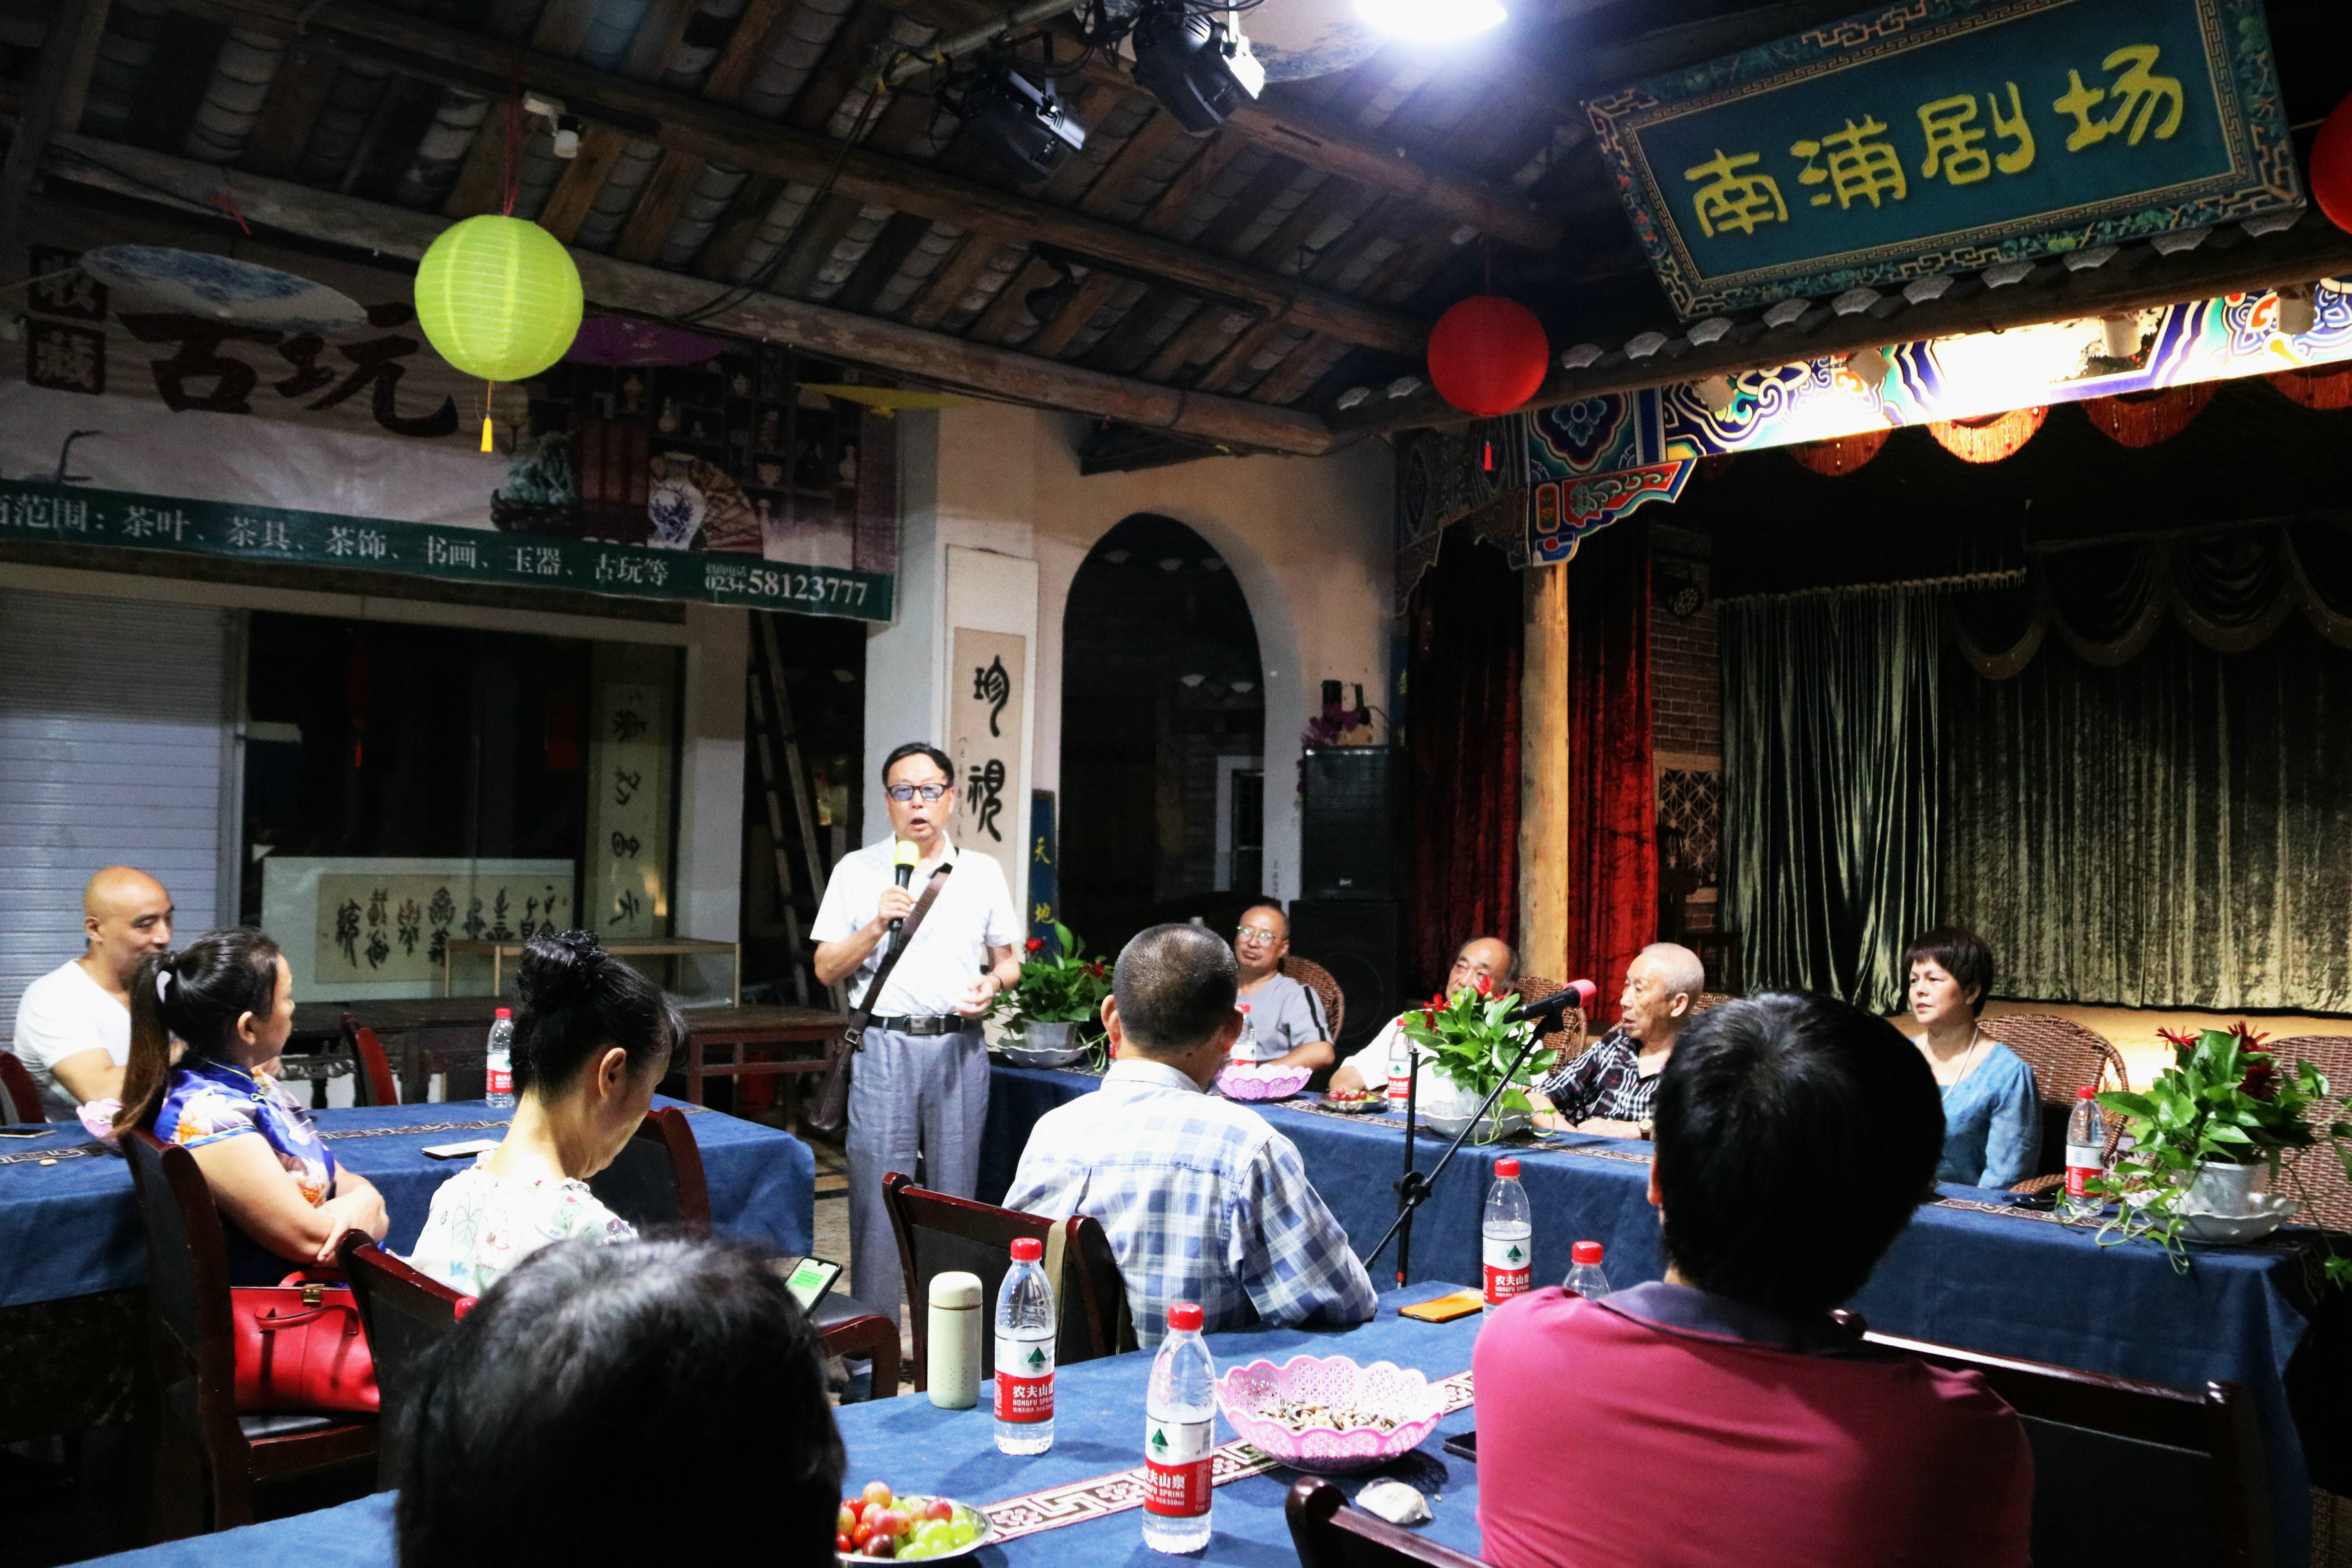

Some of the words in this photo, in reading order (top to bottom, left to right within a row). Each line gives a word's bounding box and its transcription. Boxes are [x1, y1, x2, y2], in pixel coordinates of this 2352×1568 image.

[1684, 44, 2183, 238] 南浦剧场
[112, 302, 458, 437] 古玩
[0, 493, 668, 587] 范围：茶叶、茶具、茶饰、书画、玉器、古玩等
[1013, 1380, 1054, 1399] 农夫山泉
[1159, 1488, 1185, 1498] SPRING
